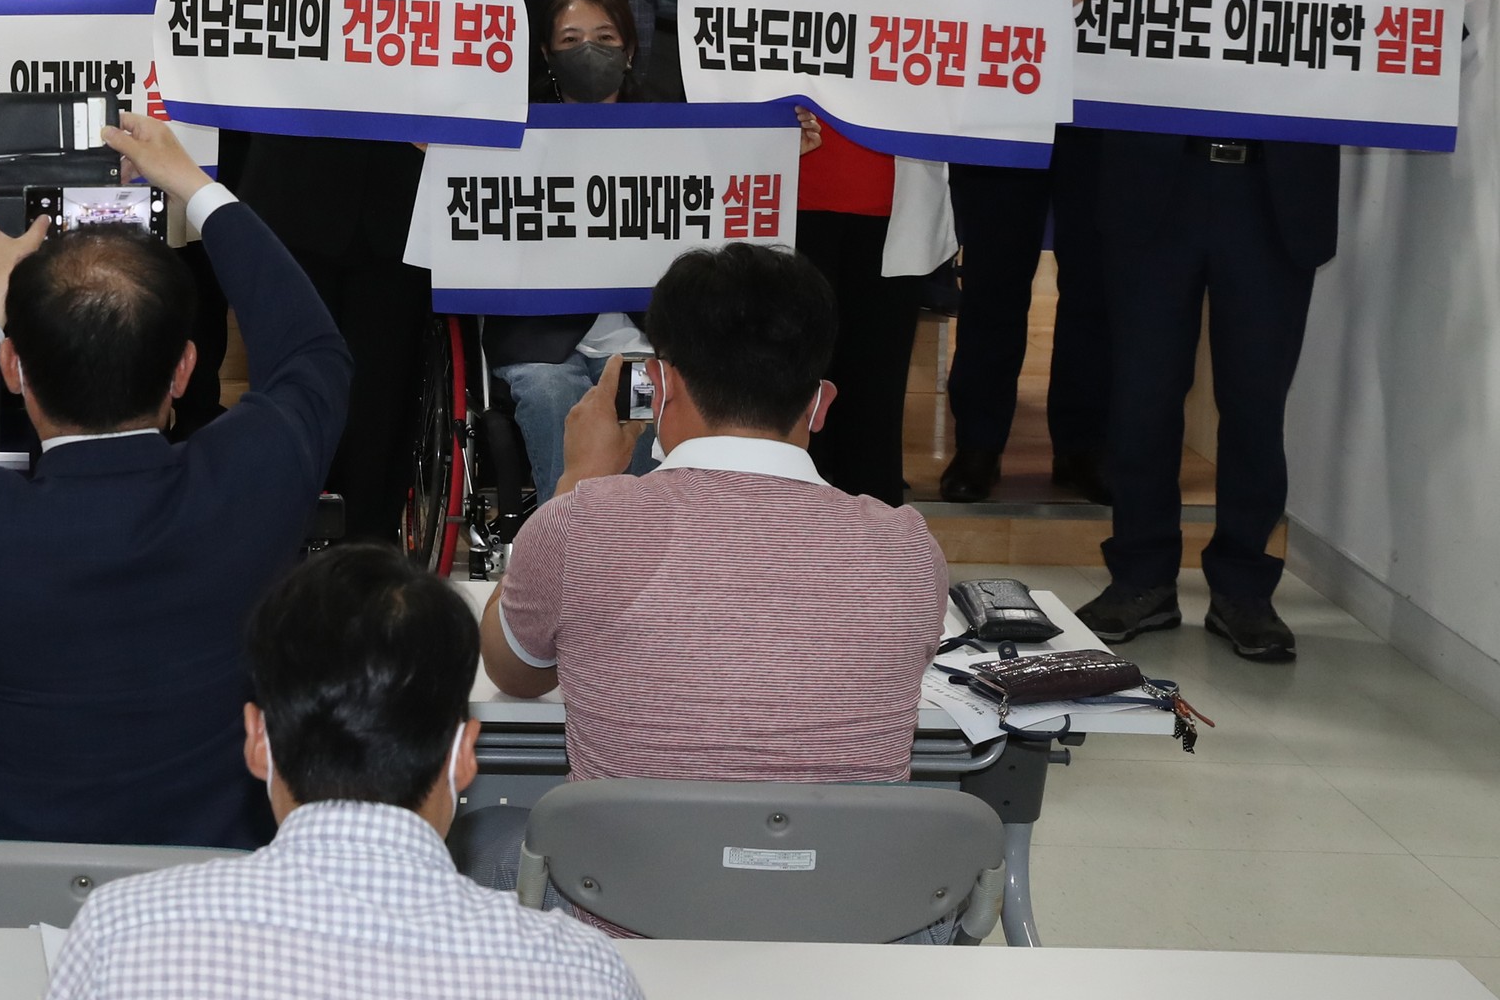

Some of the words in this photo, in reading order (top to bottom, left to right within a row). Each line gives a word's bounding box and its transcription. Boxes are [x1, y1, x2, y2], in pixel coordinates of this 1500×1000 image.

[453, 3, 516, 73] 보장
[693, 6, 858, 78] 전남도민의
[867, 15, 973, 87] 건강권
[979, 25, 1046, 95] 보장
[1374, 9, 1443, 76] 설립
[447, 175, 577, 241] 전라남도
[586, 174, 714, 241] 의과대학
[722, 174, 782, 239] 설립
